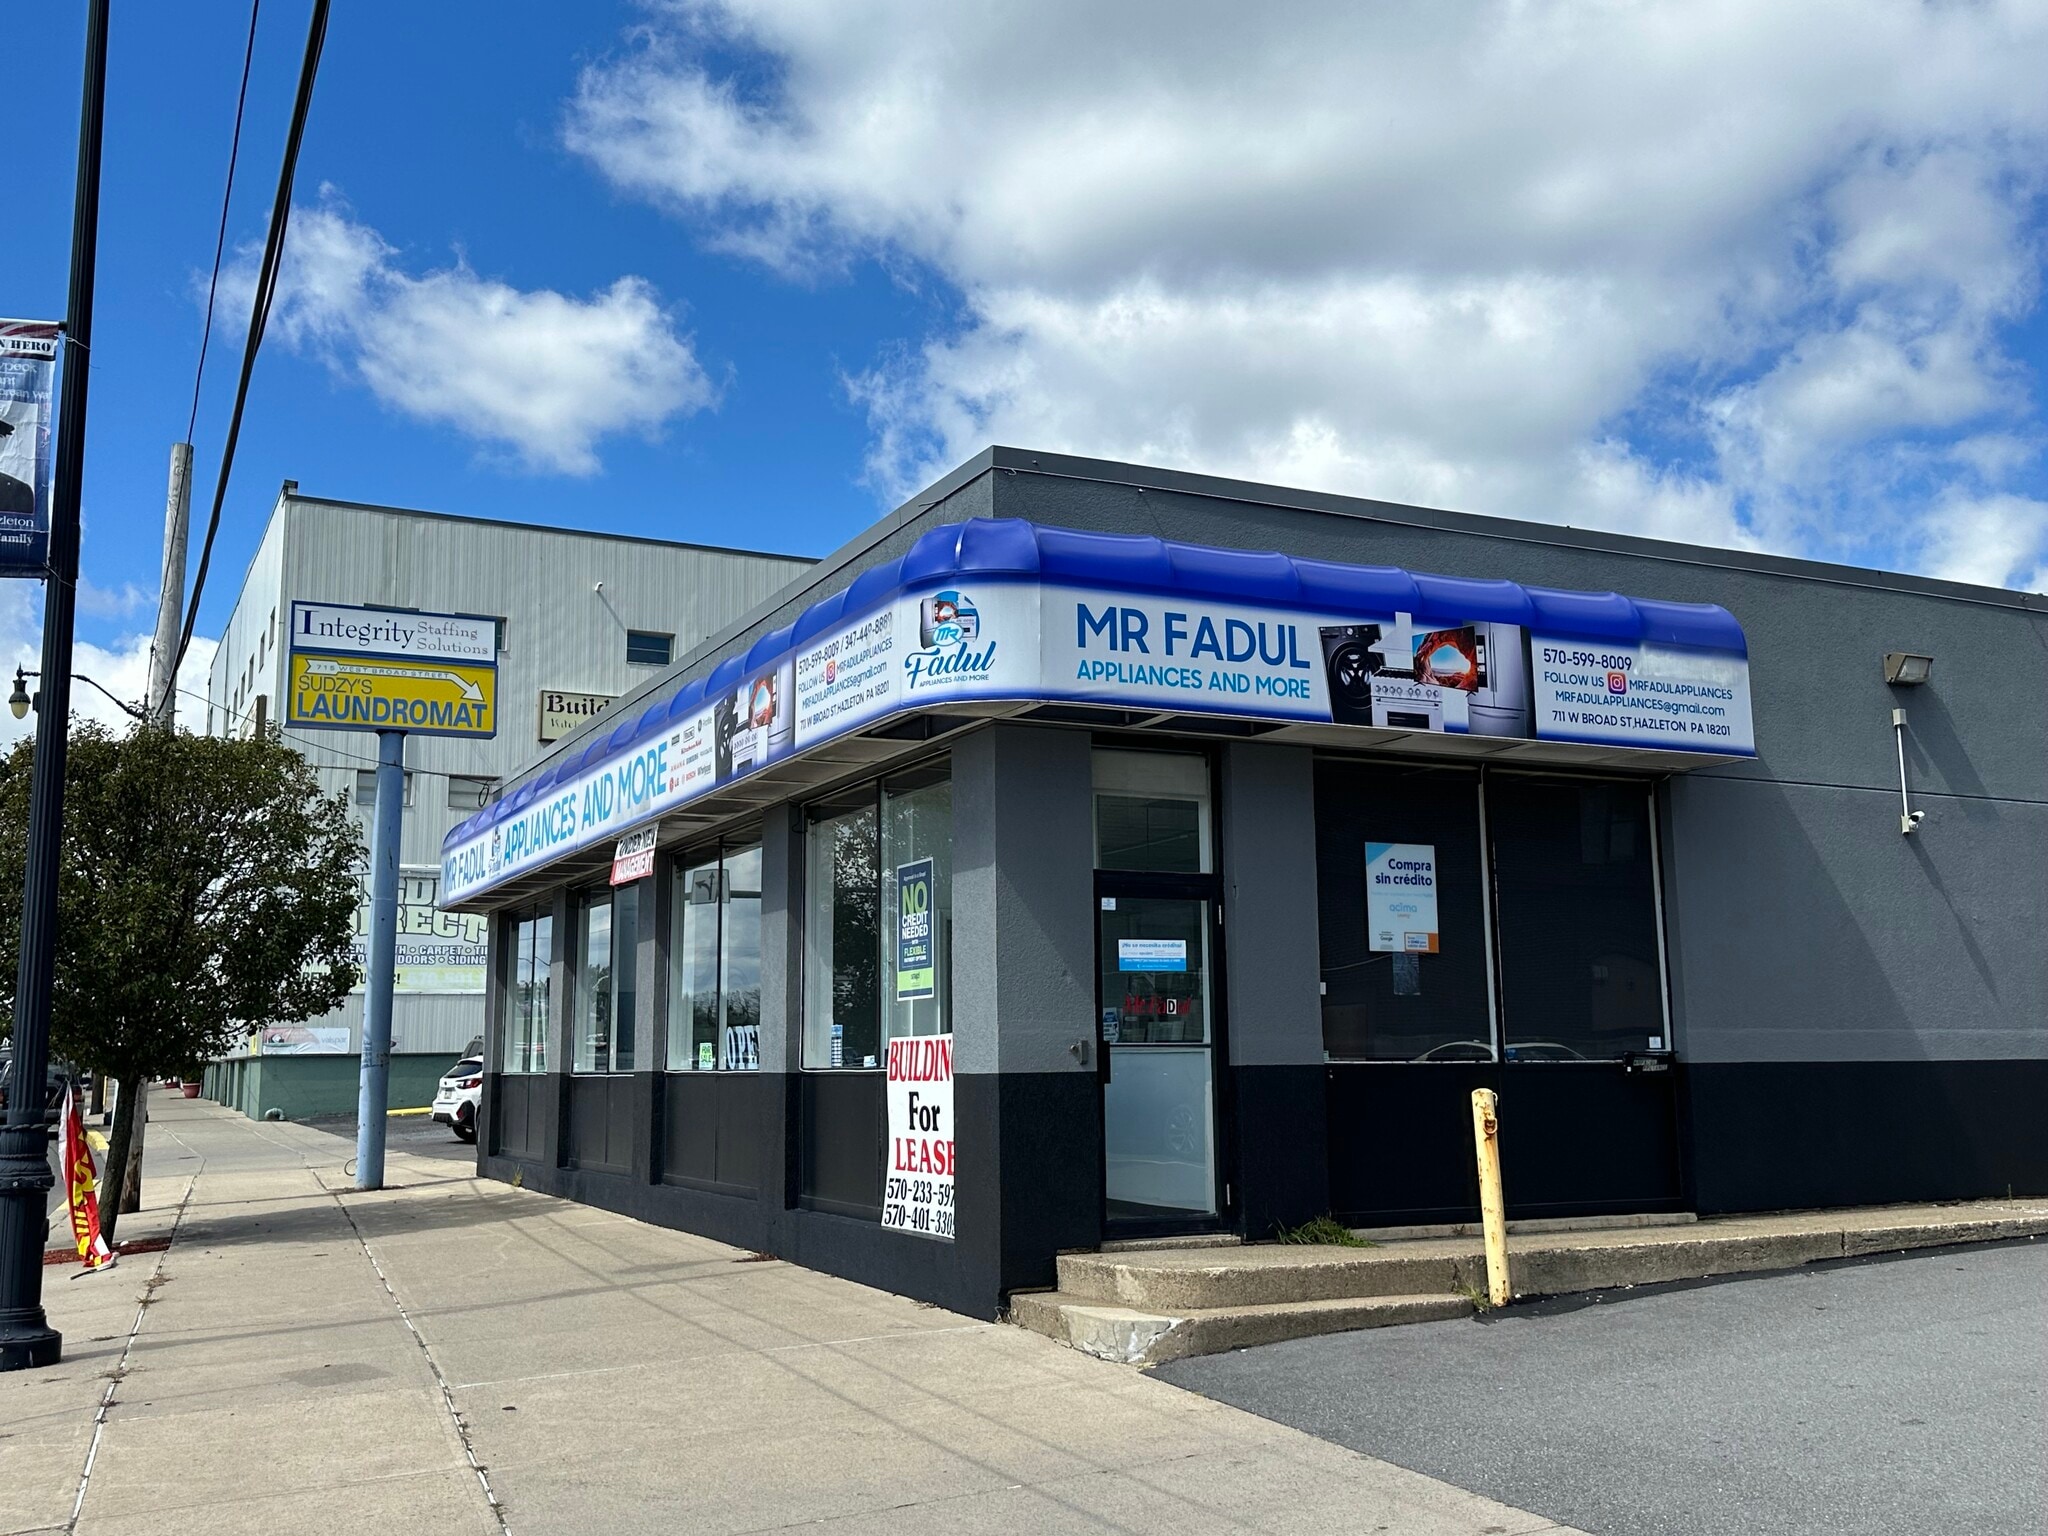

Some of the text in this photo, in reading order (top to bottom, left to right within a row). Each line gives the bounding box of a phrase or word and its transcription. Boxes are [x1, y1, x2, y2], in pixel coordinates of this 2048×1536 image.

[11, 339, 51, 352] HERO
[0, 533, 34, 547] amily
[296, 608, 416, 649] Integrity
[417, 621, 478, 640] Staffing
[1077, 603, 1311, 669] MR FADUL
[417, 638, 489, 656] Solutions
[904, 640, 997, 689] Fadul
[1543, 648, 1632, 671] 570-599-8009
[340, 665, 368, 673] WEST
[371, 668, 408, 676] BROAD
[410, 671, 450, 679] STREET
[798, 677, 818, 695] FOLLOW
[819, 671, 826, 685] US
[919, 677, 952, 688] APPLIANCES
[1076, 659, 1311, 699] APPLIANCES AND MORE
[298, 675, 373, 695] SUDZY'S
[1544, 671, 1733, 700] FOLLOW US MRFADULAPPLIANCES
[297, 691, 488, 729] LAUNDROMAT
[1555, 690, 1726, 716] MRFADULAPPLIANCES@gmail.com
[1552, 710, 1566, 722] 711
[1568, 712, 1580, 723] W
[1582, 713, 1618, 726] BROAD
[1691, 722, 1705, 734] PA
[1706, 724, 1731, 736] 18201
[444, 856, 458, 895] MR
[458, 841, 486, 889] FADUL
[503, 793, 577, 867] APPLIANCES
[581, 772, 614, 832] AND
[617, 741, 668, 815] MORE
[1388, 858, 1432, 873] Compra
[1375, 872, 1433, 886] sin crédito
[902, 880, 928, 914] NO
[1389, 902, 1418, 912] acima
[902, 910, 929, 928] CREDIT
[901, 924, 929, 940] NEEDED
[397, 955, 487, 965] DOORS SIDING
[419, 944, 463, 955] CARPET
[889, 1038, 954, 1082] BUILDIN
[908, 1091, 941, 1132] For
[895, 1137, 955, 1176] LEASE
